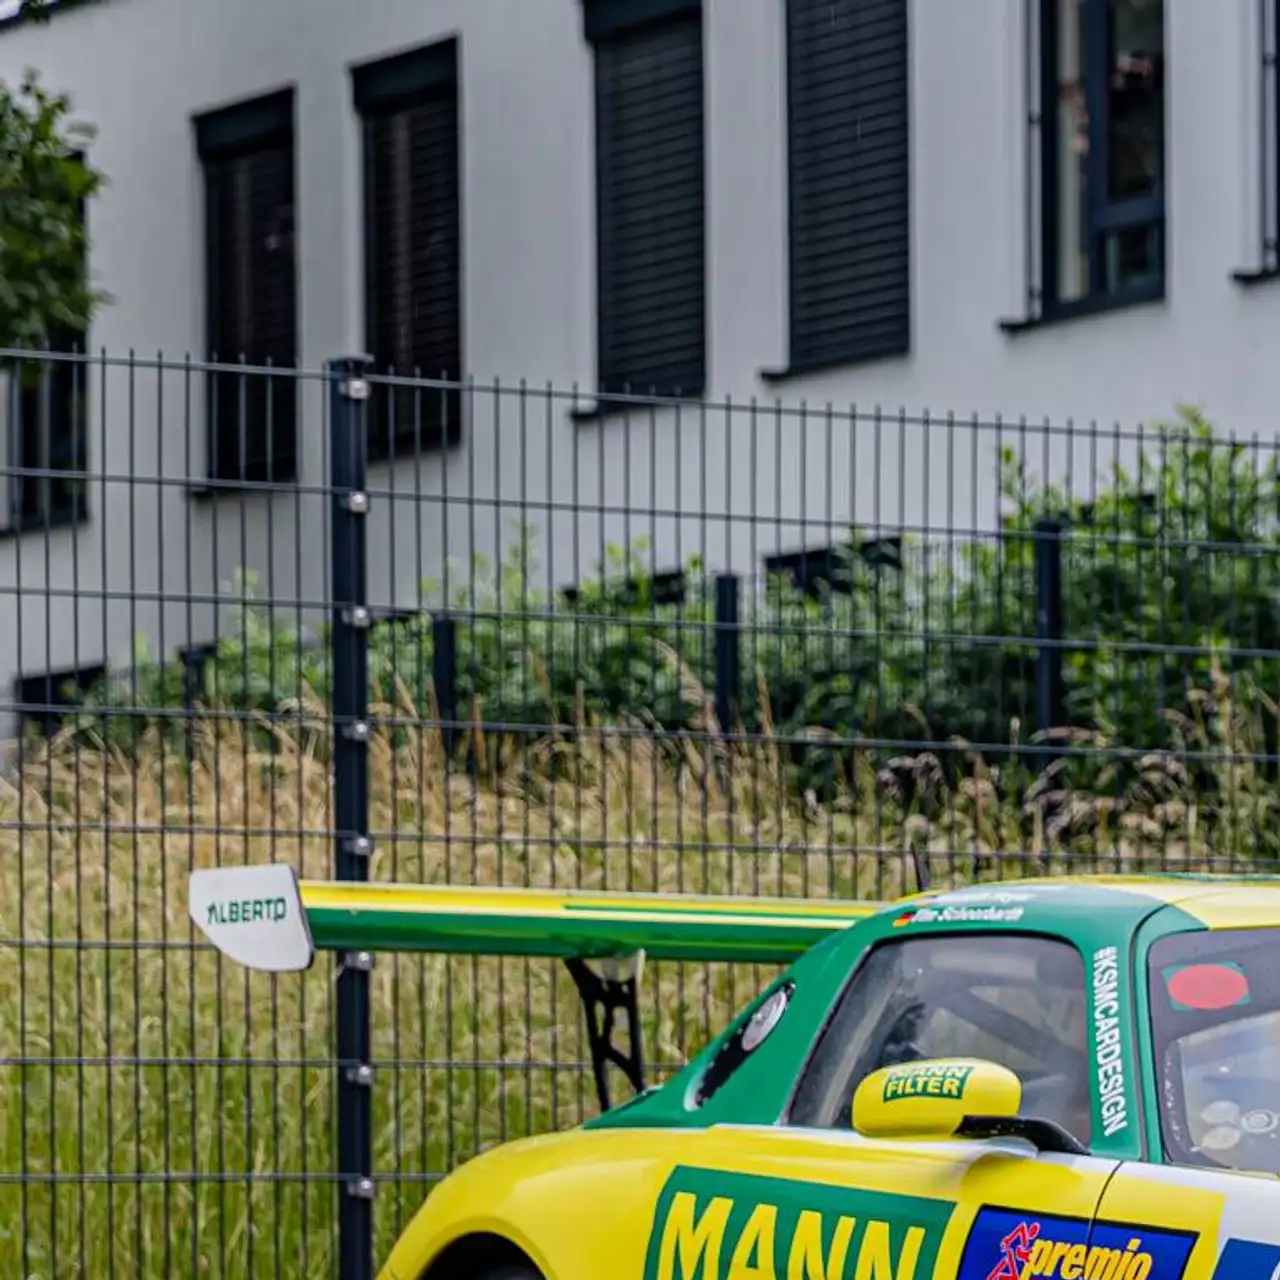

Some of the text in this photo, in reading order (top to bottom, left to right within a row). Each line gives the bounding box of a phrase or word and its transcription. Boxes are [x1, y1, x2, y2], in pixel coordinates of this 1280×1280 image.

[207, 898, 286, 924] ALBERTO
[1092, 945, 1128, 1137] #KSMCARDESIGN
[885, 1077, 961, 1099] FILTER
